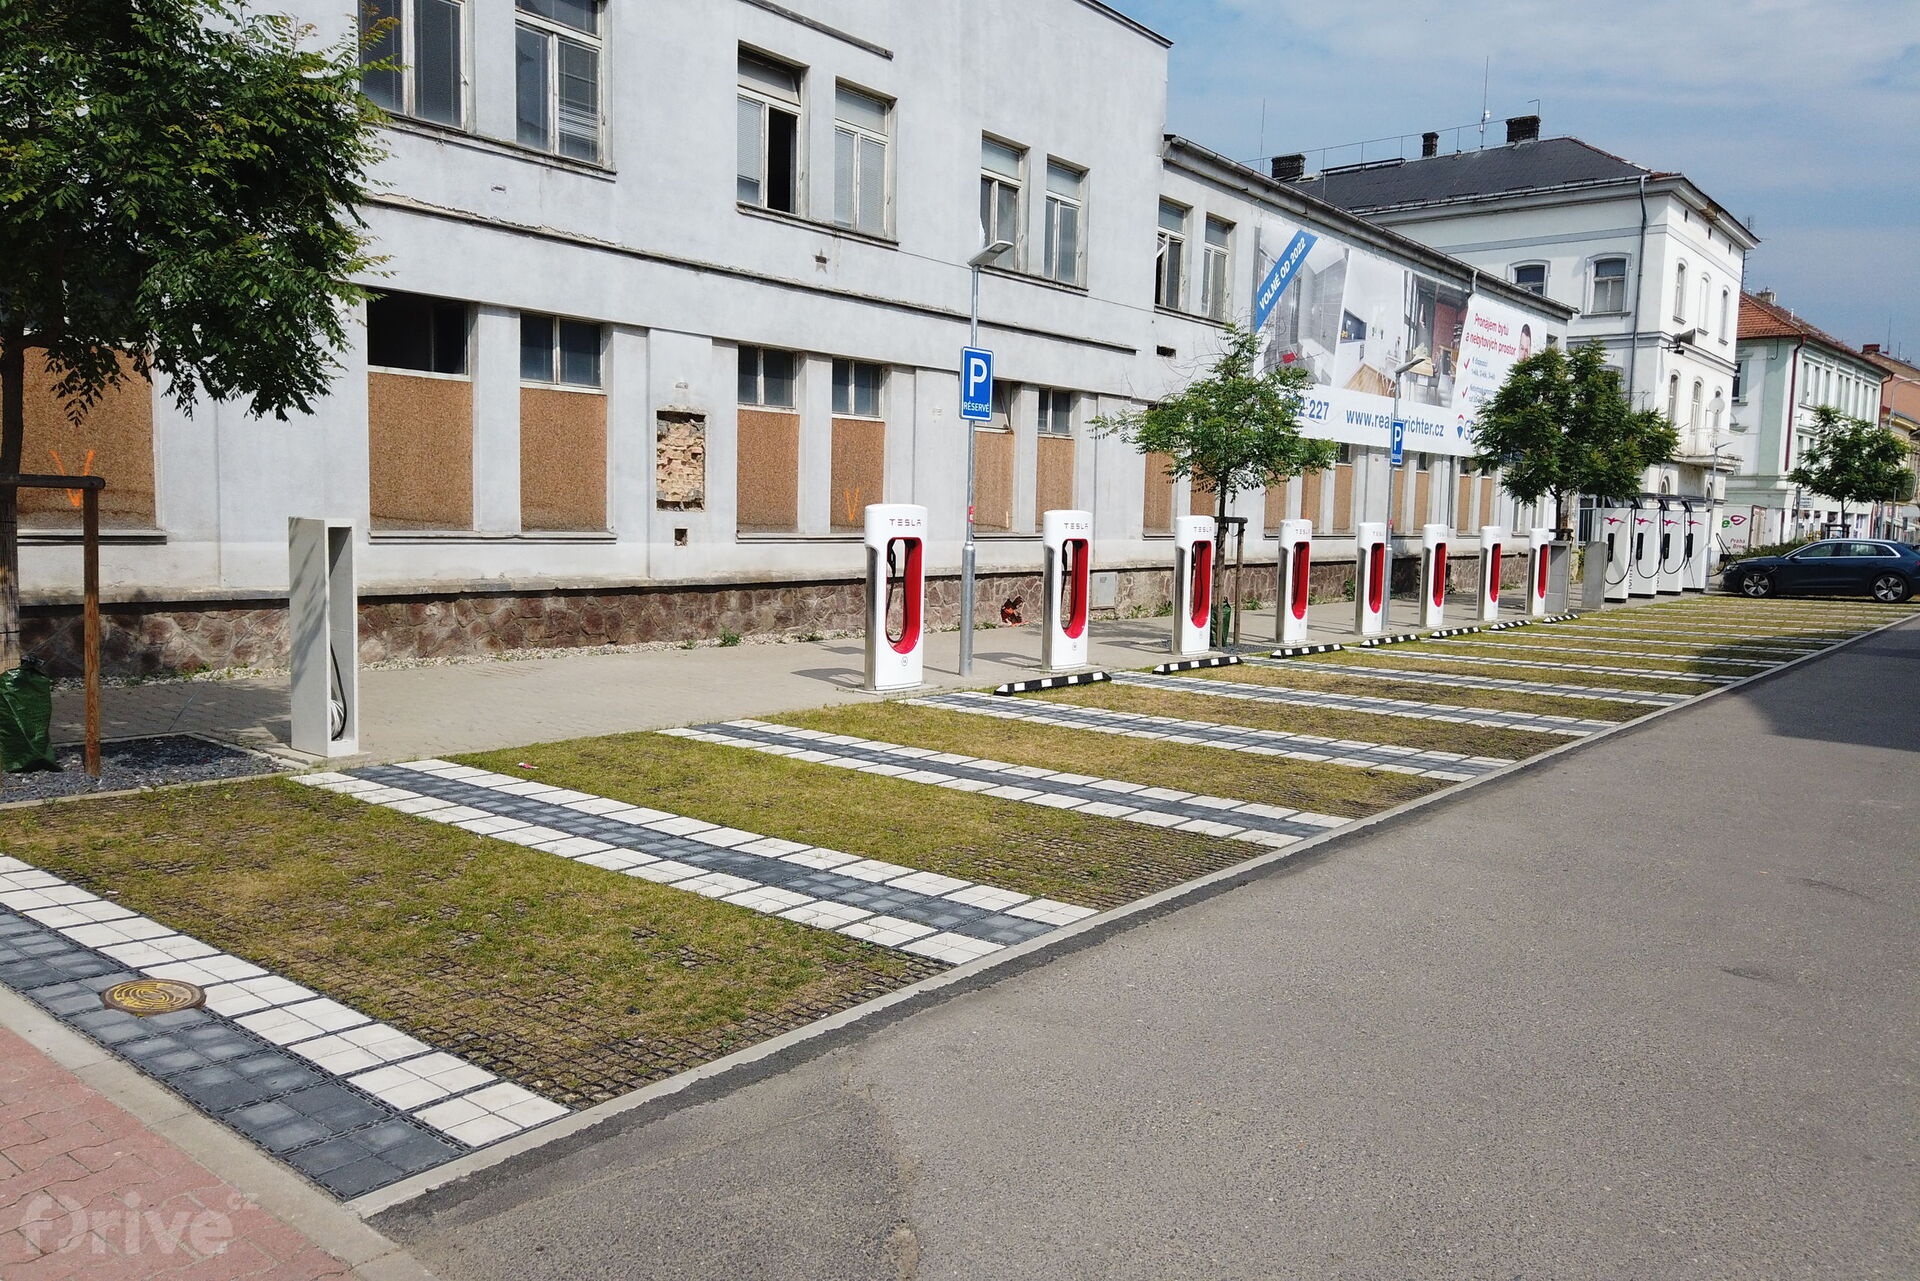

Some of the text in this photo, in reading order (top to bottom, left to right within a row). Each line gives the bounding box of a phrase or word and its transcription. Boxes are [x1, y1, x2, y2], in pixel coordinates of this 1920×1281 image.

[1259, 237, 1306, 310] VOLNÉ OD 2022
[969, 357, 988, 397] P
[963, 401, 990, 413] RÉSERVÉ
[1308, 399, 1330, 420] 227
[1346, 409, 1445, 438] www.realrichter.cz
[1394, 426, 1402, 451] P
[889, 518, 922, 527] TESLA
[1064, 522, 1089, 530] TESLA
